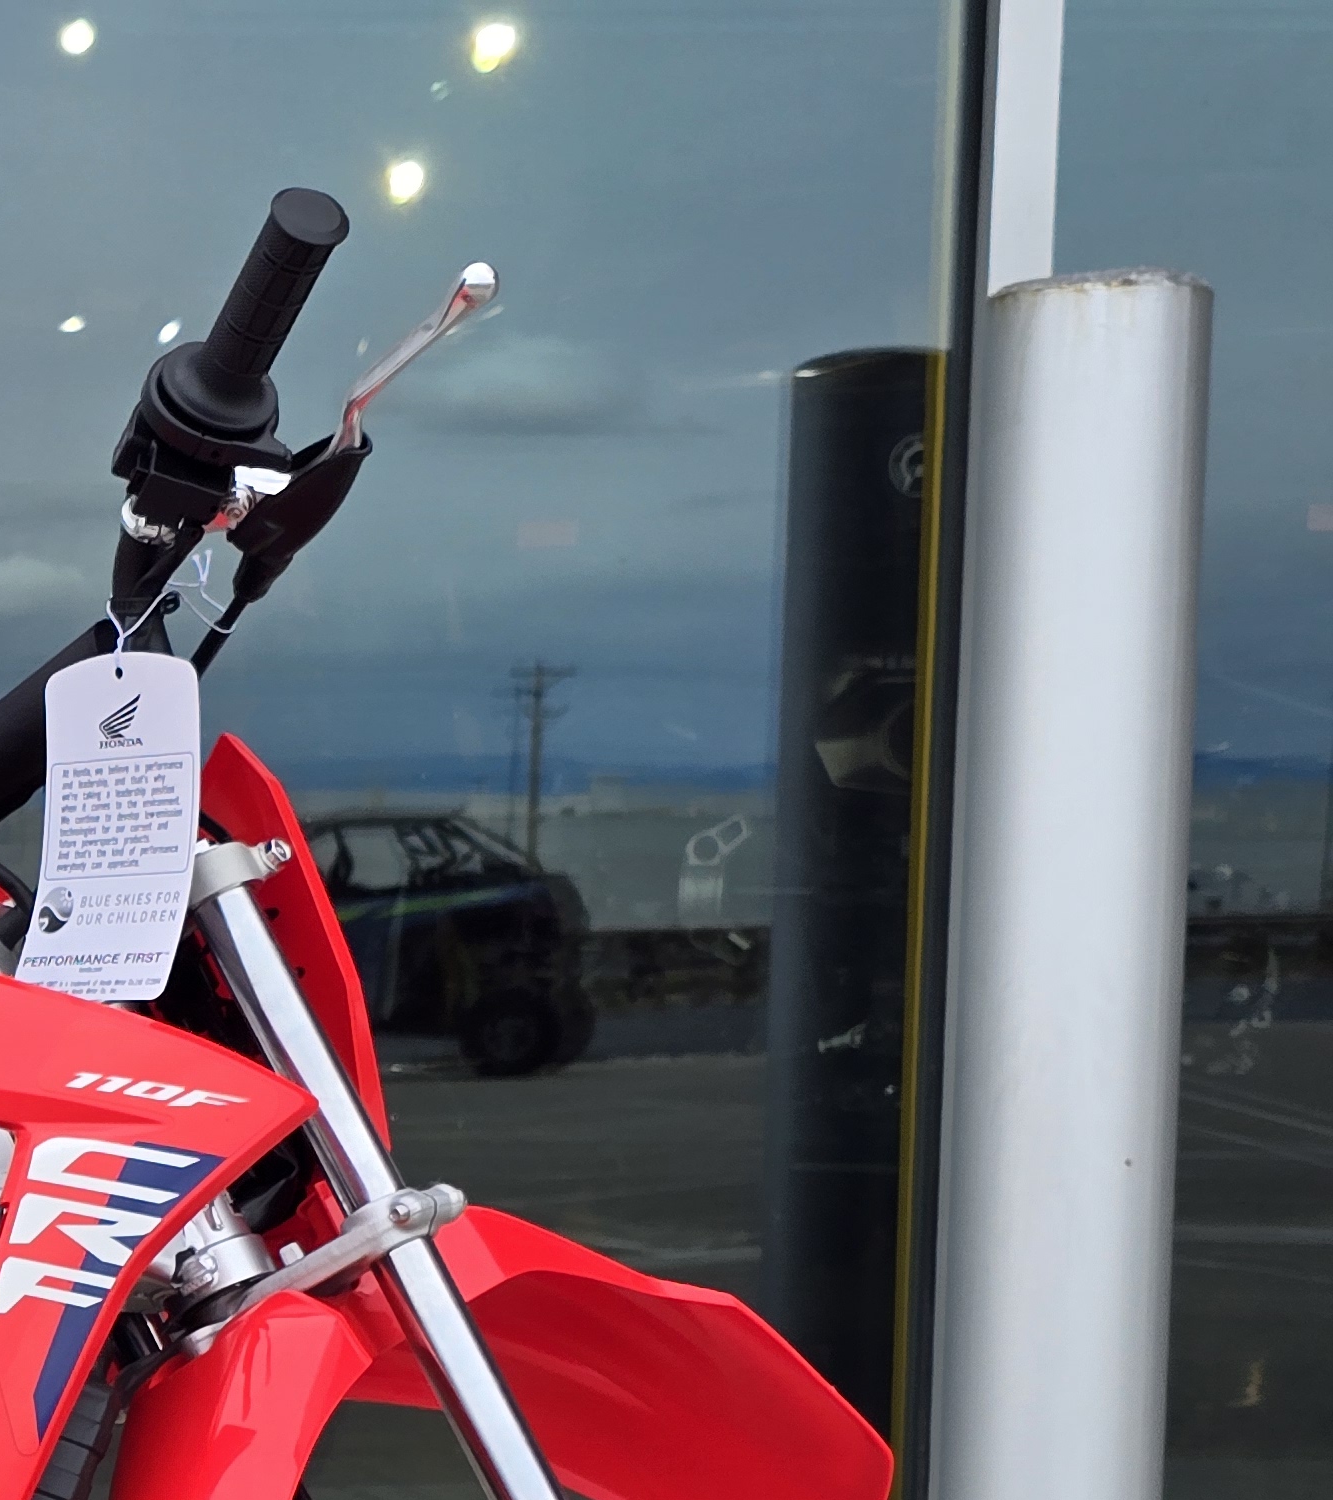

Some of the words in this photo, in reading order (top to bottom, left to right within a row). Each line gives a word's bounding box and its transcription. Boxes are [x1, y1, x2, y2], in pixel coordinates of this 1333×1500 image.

[99, 738, 143, 749] HONDA
[80, 895, 111, 908] BLUE
[115, 893, 151, 906] SKIES
[156, 891, 180, 903] FOR
[77, 913, 103, 925] OUR
[107, 910, 177, 924] CHILDREN
[23, 954, 120, 967] PERFORMANCE
[66, 1071, 250, 1108] 110F
